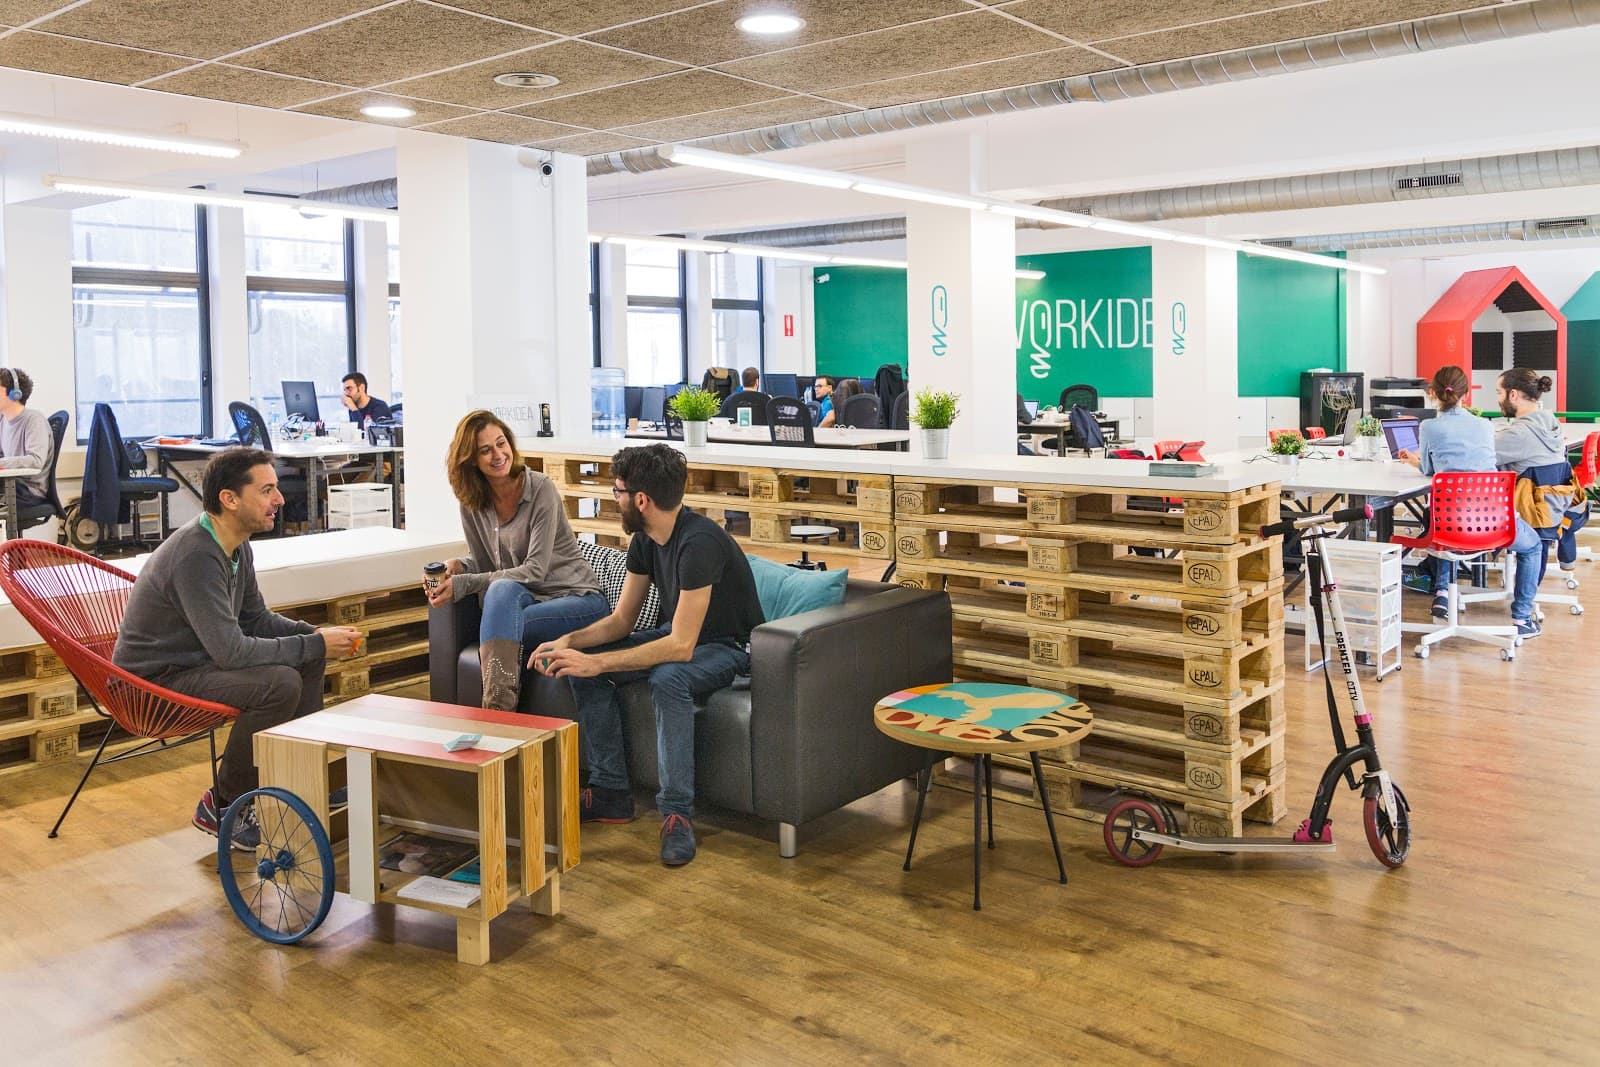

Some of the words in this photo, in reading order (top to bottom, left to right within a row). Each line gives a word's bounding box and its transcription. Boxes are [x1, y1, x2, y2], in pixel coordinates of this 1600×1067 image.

[865, 535, 883, 548] EPAL
[901, 540, 919, 552] EPAL
[1193, 567, 1216, 581] EPAL
[1190, 616, 1215, 632] EPAL
[1335, 631, 1352, 674] PREMIER
[1347, 681, 1359, 701] CITY
[1194, 669, 1218, 684] EPAL
[1193, 718, 1218, 734] EPAL
[1194, 770, 1218, 786] EPAL
